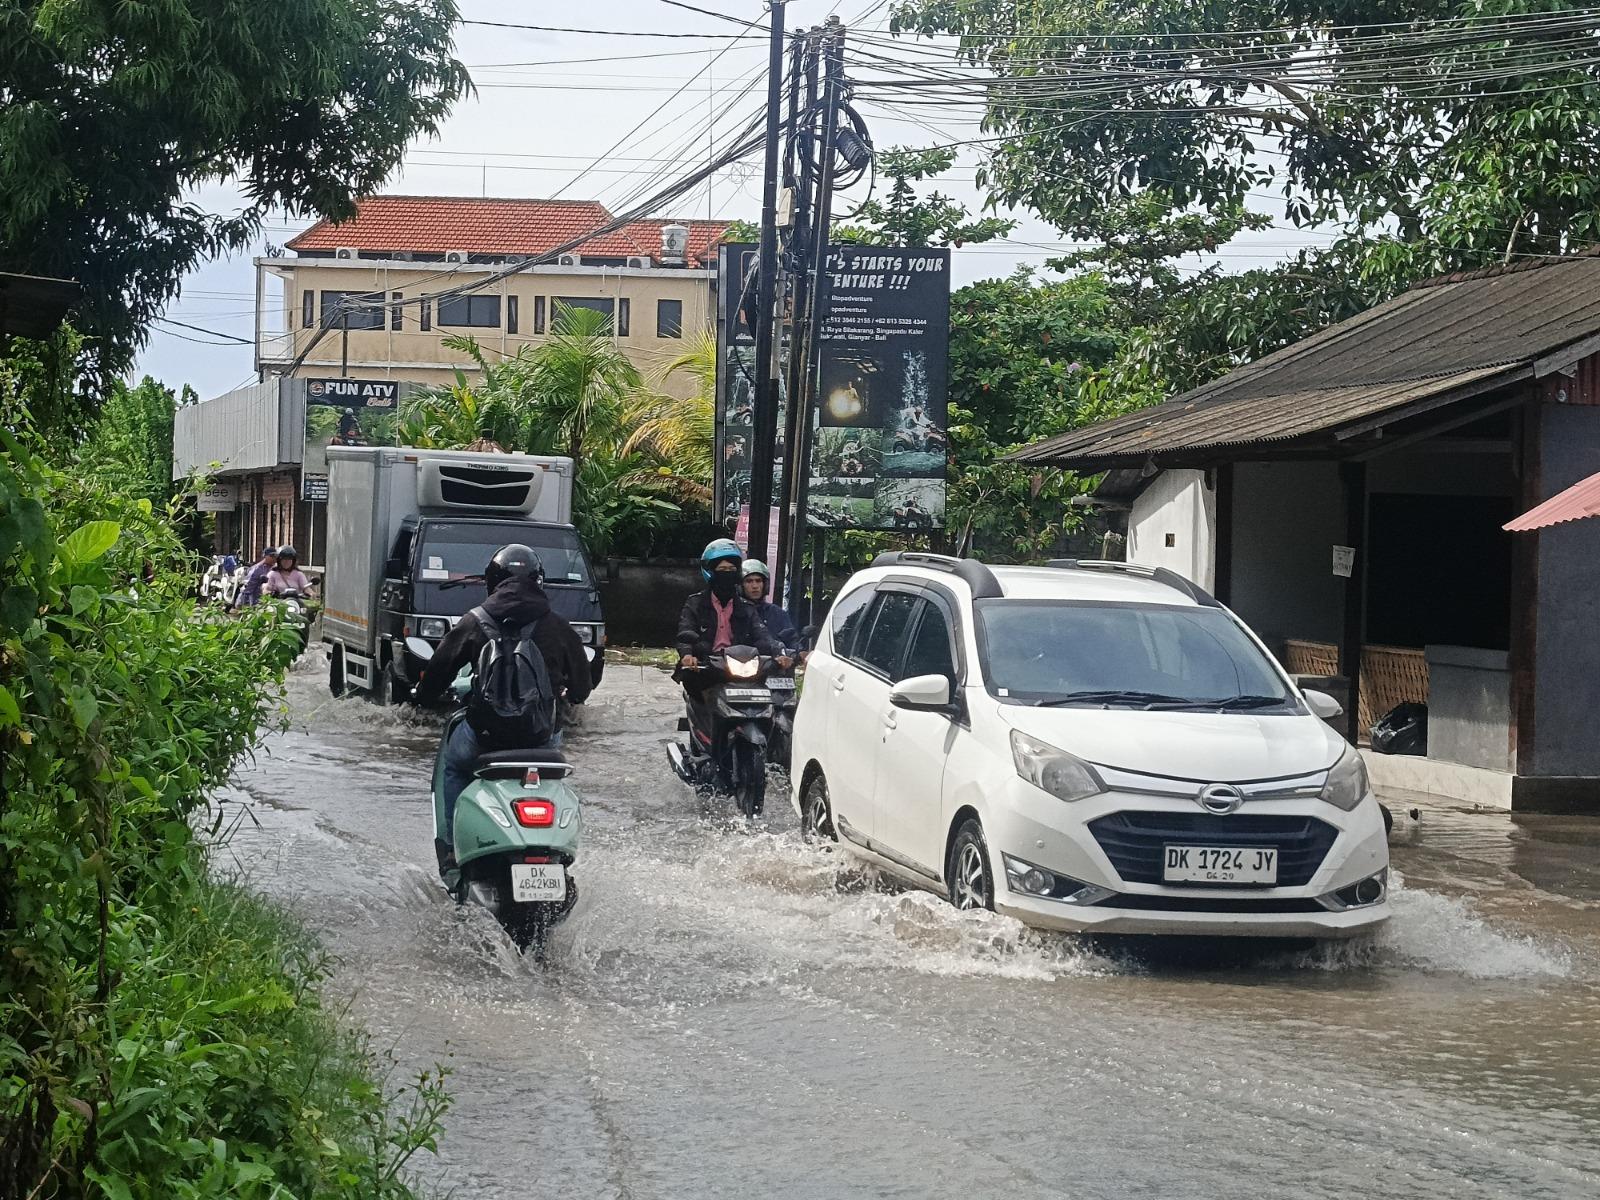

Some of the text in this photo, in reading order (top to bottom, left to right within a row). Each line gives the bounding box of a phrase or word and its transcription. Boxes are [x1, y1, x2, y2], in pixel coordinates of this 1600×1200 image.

[825, 254, 944, 272] T'S STARTS YOUR
[832, 273, 911, 290] ENTURE !!!
[325, 382, 394, 397] FUN ATV
[1167, 849, 1274, 872] DK 1724 JY
[531, 867, 546, 878] DK
